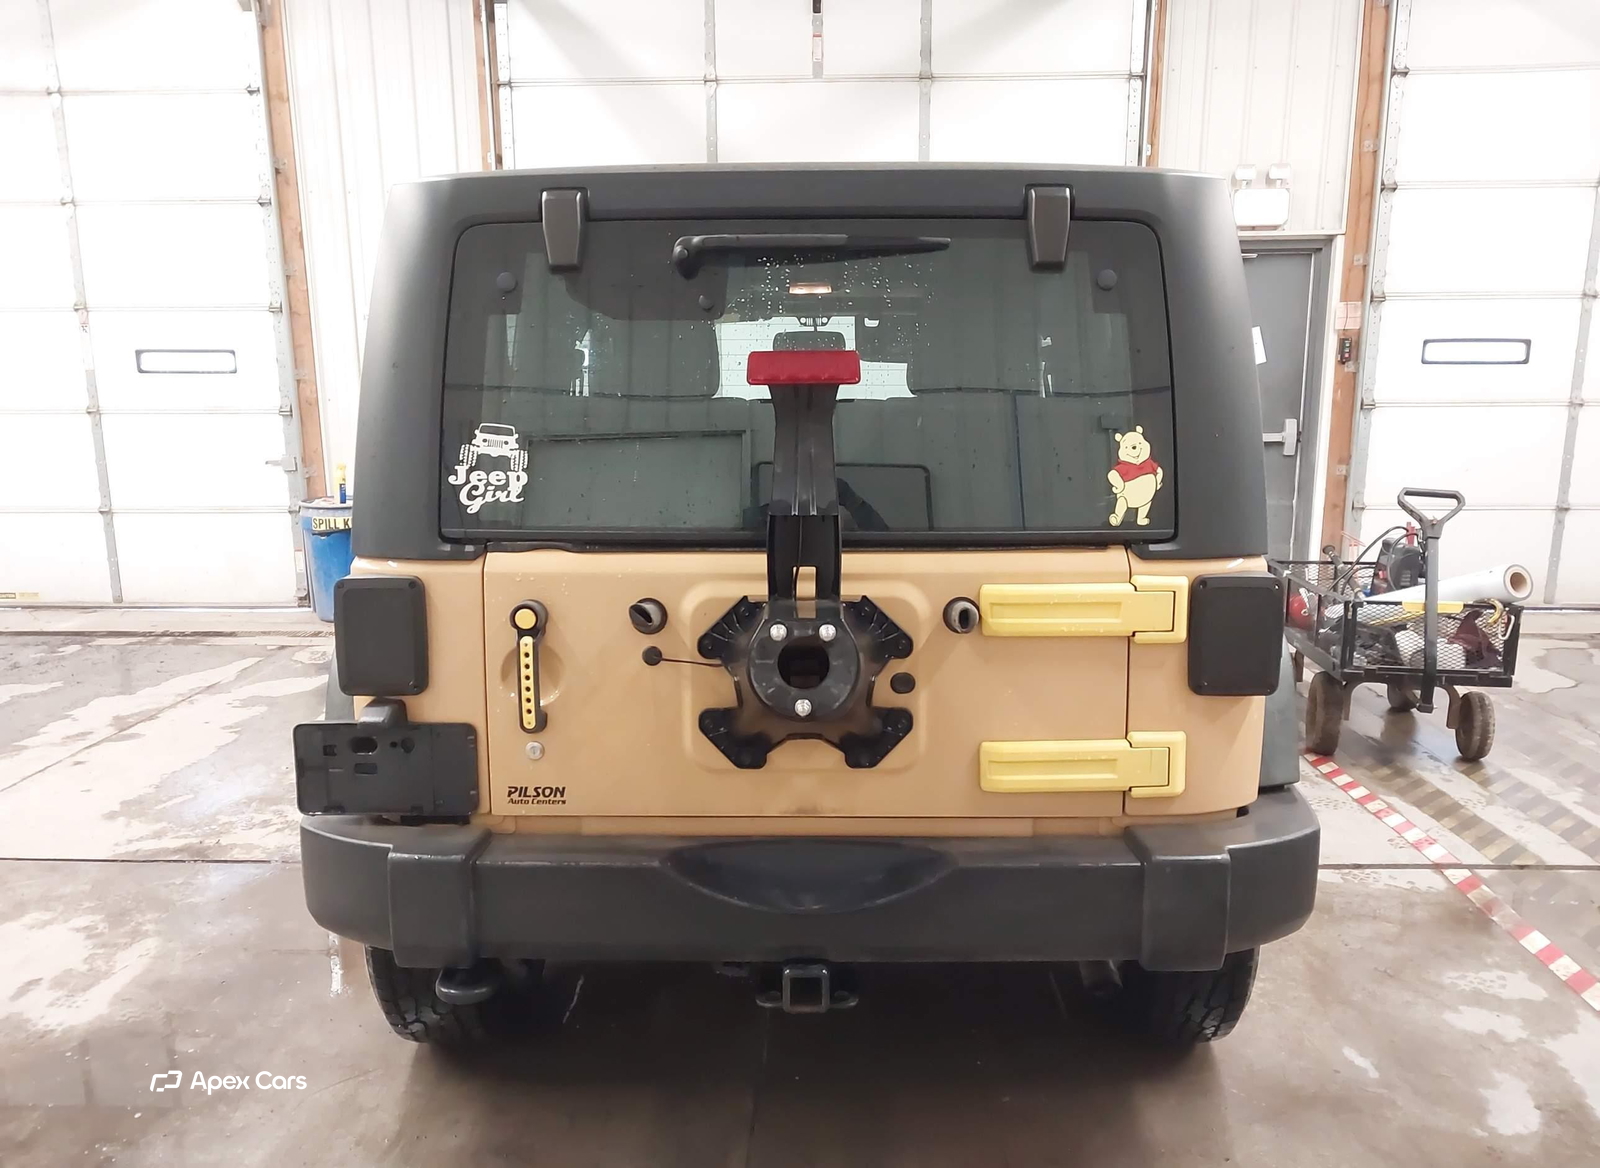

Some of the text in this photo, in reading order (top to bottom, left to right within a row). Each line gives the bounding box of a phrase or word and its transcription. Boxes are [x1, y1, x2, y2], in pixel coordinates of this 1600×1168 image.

[448, 465, 528, 490] Jeep
[460, 483, 524, 514] Girl
[312, 517, 352, 530] SPILL K
[507, 786, 566, 798] PILSON
